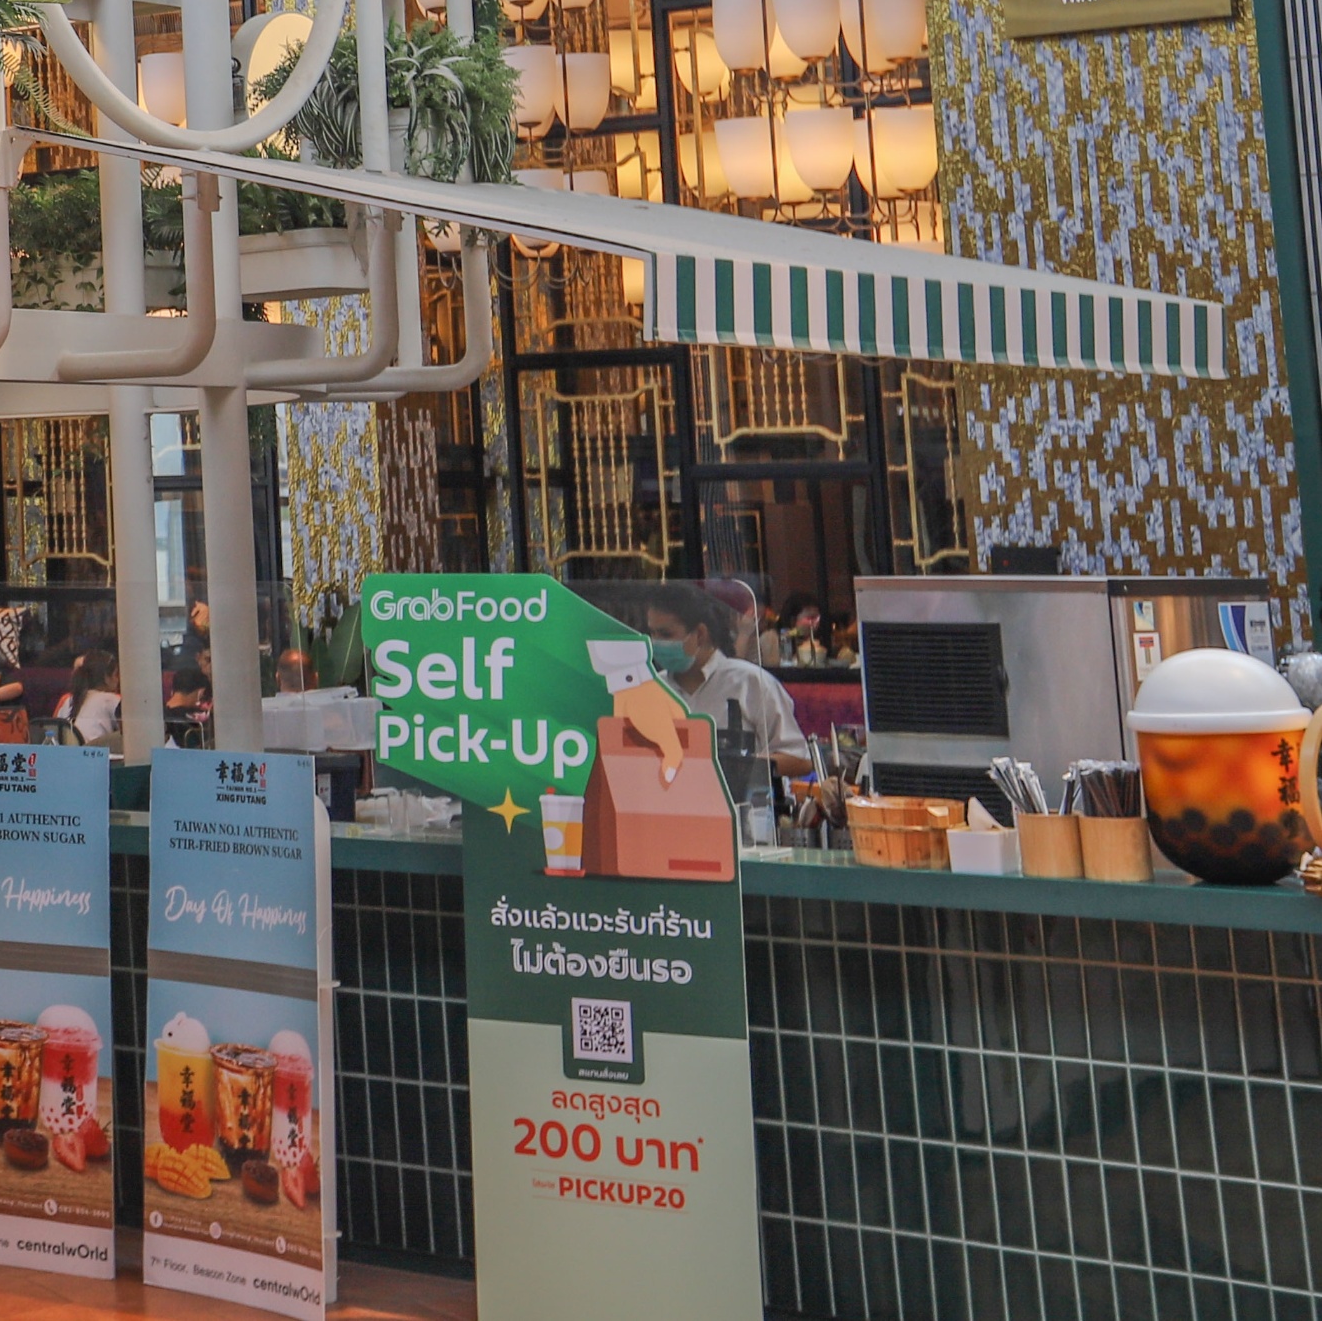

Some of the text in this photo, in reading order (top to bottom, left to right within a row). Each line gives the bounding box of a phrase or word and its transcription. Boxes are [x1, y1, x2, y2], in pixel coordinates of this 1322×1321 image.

[370, 588, 547, 622] GrabFood
[375, 637, 515, 700] Self
[379, 714, 589, 779] Pick-Up
[0, 783, 10, 792] FU
[12, 784, 37, 793] TANG
[215, 760, 259, 785] 幸福堂
[216, 793, 267, 806] XING FU TANG
[7, 813, 81, 827] AUTHENTIC
[174, 819, 299, 842] TAIWAN NO.1 AUTHENTIC
[43, 832, 86, 845] SUGAR
[169, 838, 303, 861] STIR-FRIED BROWN SUGAR
[1, 876, 91, 915] Happiness
[164, 885, 307, 935] Day Of Happiness
[491, 895, 712, 939] สั่งแล้วแวะรับที่ร้าน
[510, 938, 693, 985] ไม่ต้องยืนรอ
[552, 1090, 661, 1124] ลดสูงสุด
[514, 1117, 602, 1163] 200
[559, 1176, 686, 1210] PICKUP20
[16, 1238, 109, 1262] centralwOrld
[253, 1277, 321, 1306] centralwOrld
